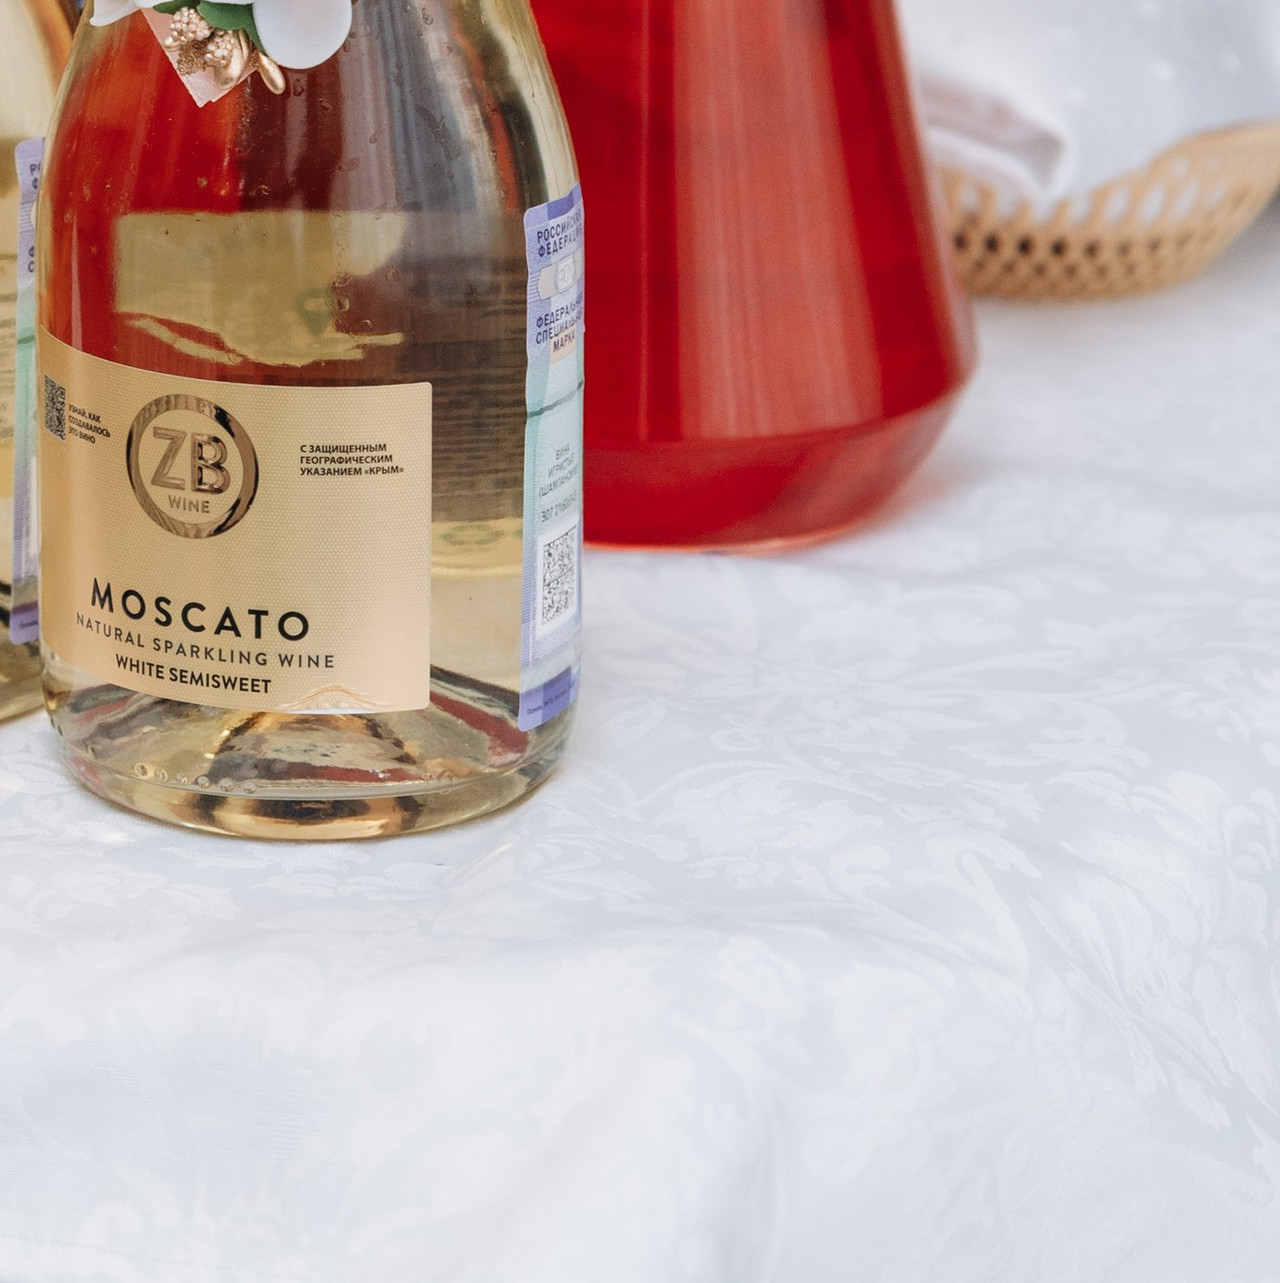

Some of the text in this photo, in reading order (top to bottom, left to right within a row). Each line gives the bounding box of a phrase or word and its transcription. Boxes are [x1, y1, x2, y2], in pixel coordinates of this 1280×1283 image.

[151, 426, 231, 495] ZB
[300, 443, 387, 454] С ЗАЩИЩЕННЫМ
[300, 454, 393, 465] ГЕОГРАФИЧЕСКИМ
[300, 465, 404, 476] УКАЗАНИЕМ «КРЫМ»
[168, 494, 210, 514] WINE
[90, 577, 310, 642] MOSCATO
[76, 612, 335, 669] NATURAL SPARKLING WINE
[115, 653, 272, 694] WHITE SEMISWEET
